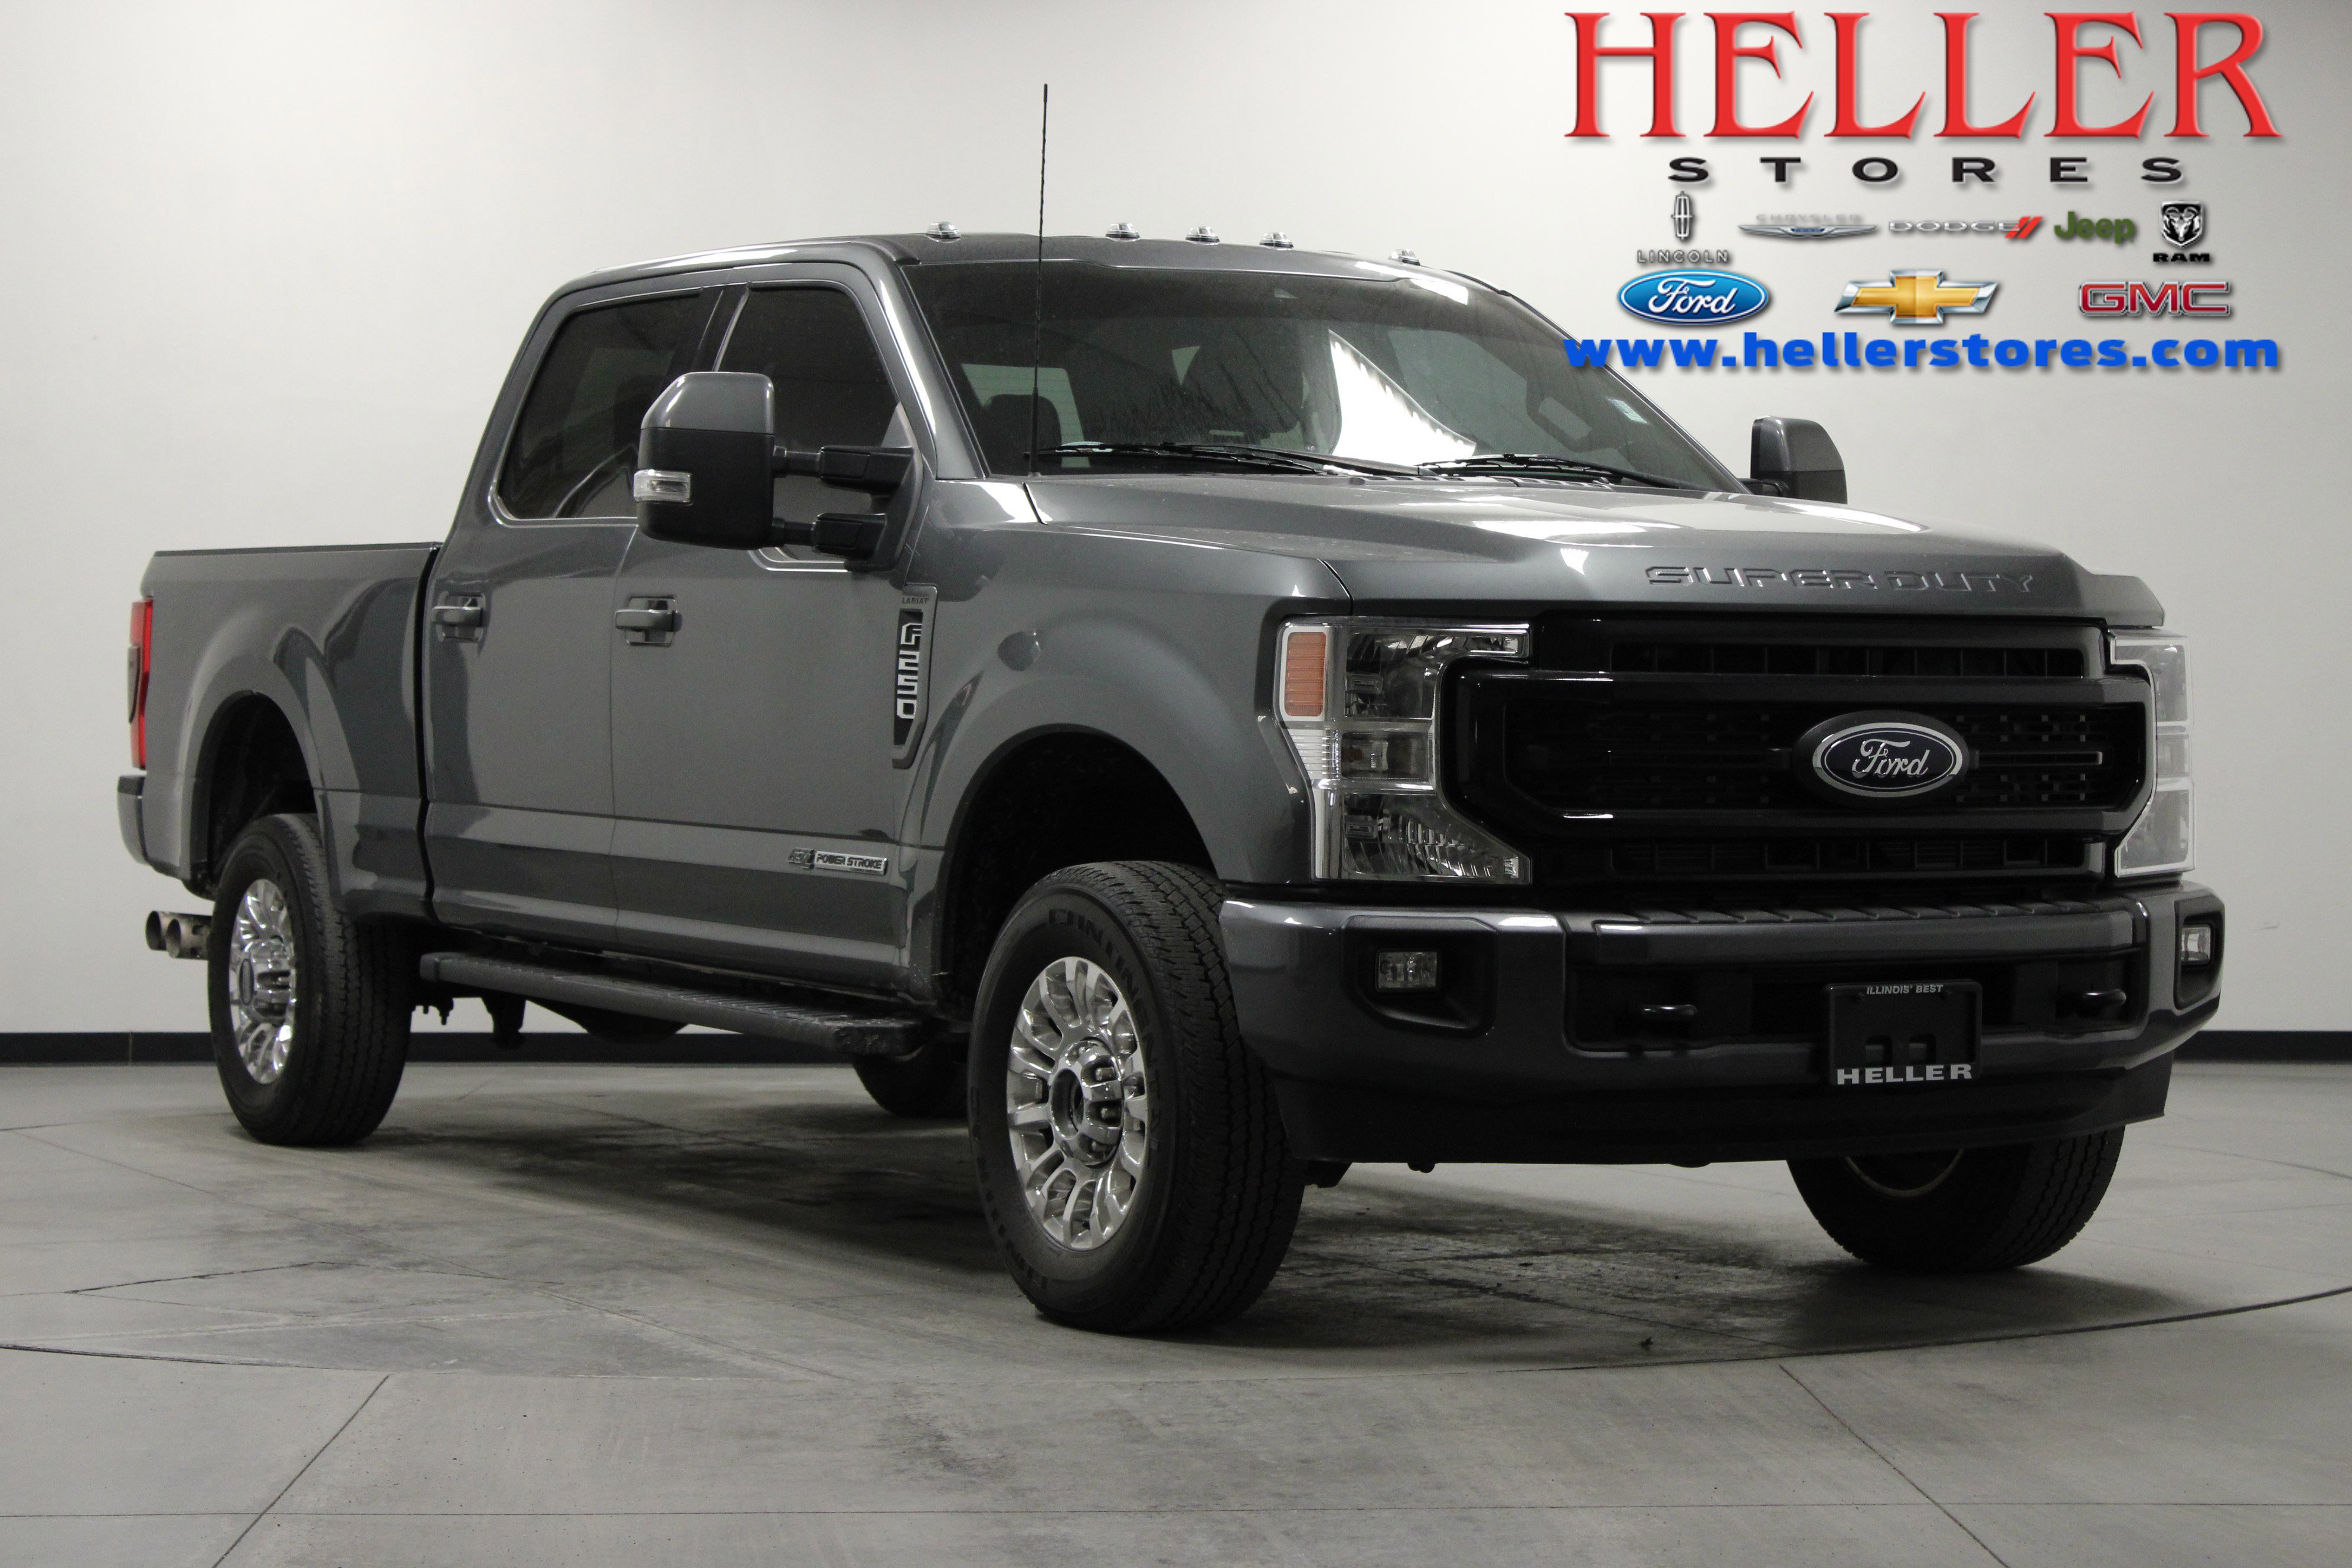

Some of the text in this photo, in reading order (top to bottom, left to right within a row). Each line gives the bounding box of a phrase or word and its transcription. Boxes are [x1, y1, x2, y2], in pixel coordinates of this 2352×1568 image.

[1645, 566, 2034, 592] SUPER DUTY
[1851, 739, 1930, 778] Ford
[816, 854, 882, 870] POWER STROKE
[1916, 984, 1943, 993] BEST
[1837, 1064, 1972, 1085] HELLER
